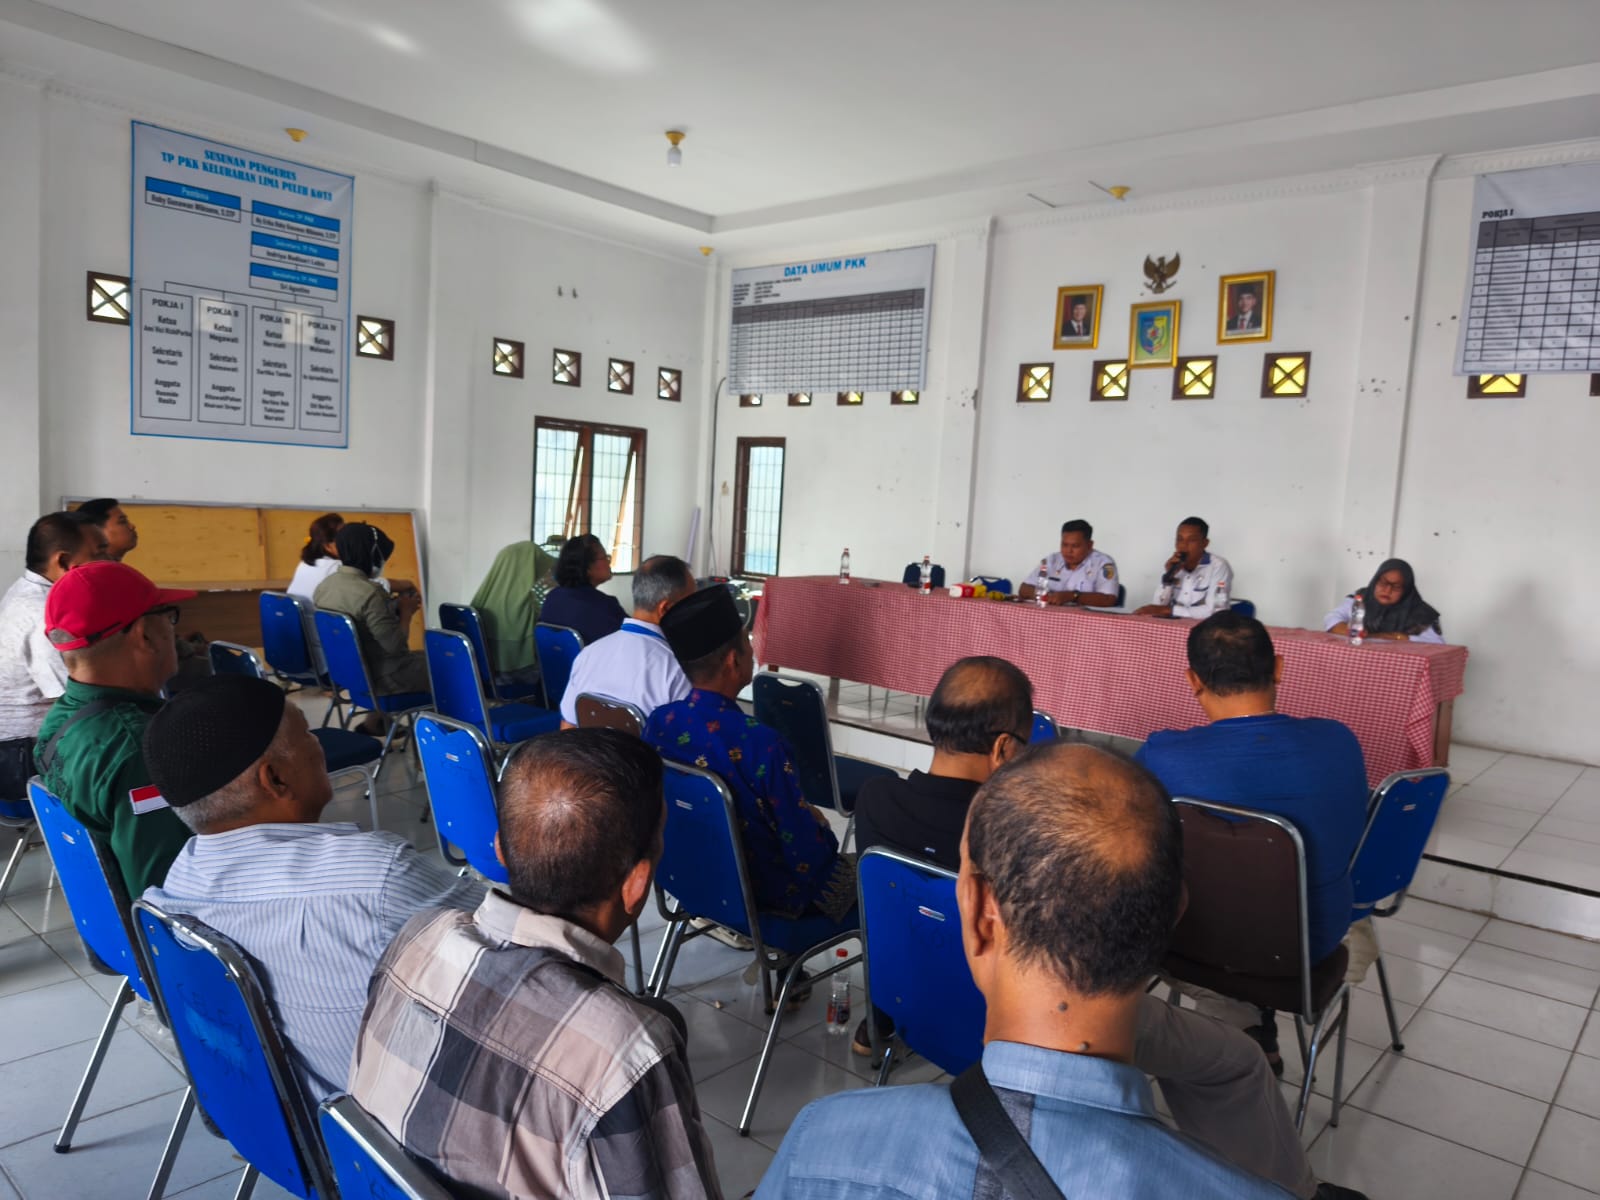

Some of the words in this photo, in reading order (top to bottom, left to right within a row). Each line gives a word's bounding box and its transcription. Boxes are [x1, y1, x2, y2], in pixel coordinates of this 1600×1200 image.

[204, 149, 246, 168] SUSUNAN
[249, 160, 297, 181] PENGURUS
[161, 151, 175, 163] TP
[178, 155, 199, 170] PKK
[202, 161, 256, 183] KELURAHAN
[259, 175, 279, 189] LIMA
[282, 181, 308, 196] PULUH
[311, 188, 333, 202] KOTA
[1481, 209, 1509, 219] POKJA
[784, 265, 808, 277] DATA
[811, 260, 842, 274] UMUM
[845, 256, 867, 270] PKK
[152, 298, 179, 309] POKJA
[207, 306, 233, 317] POKJA
[260, 314, 283, 324] POKJA
[308, 321, 329, 331] POKJA
[152, 346, 183, 358] Sekretaris
